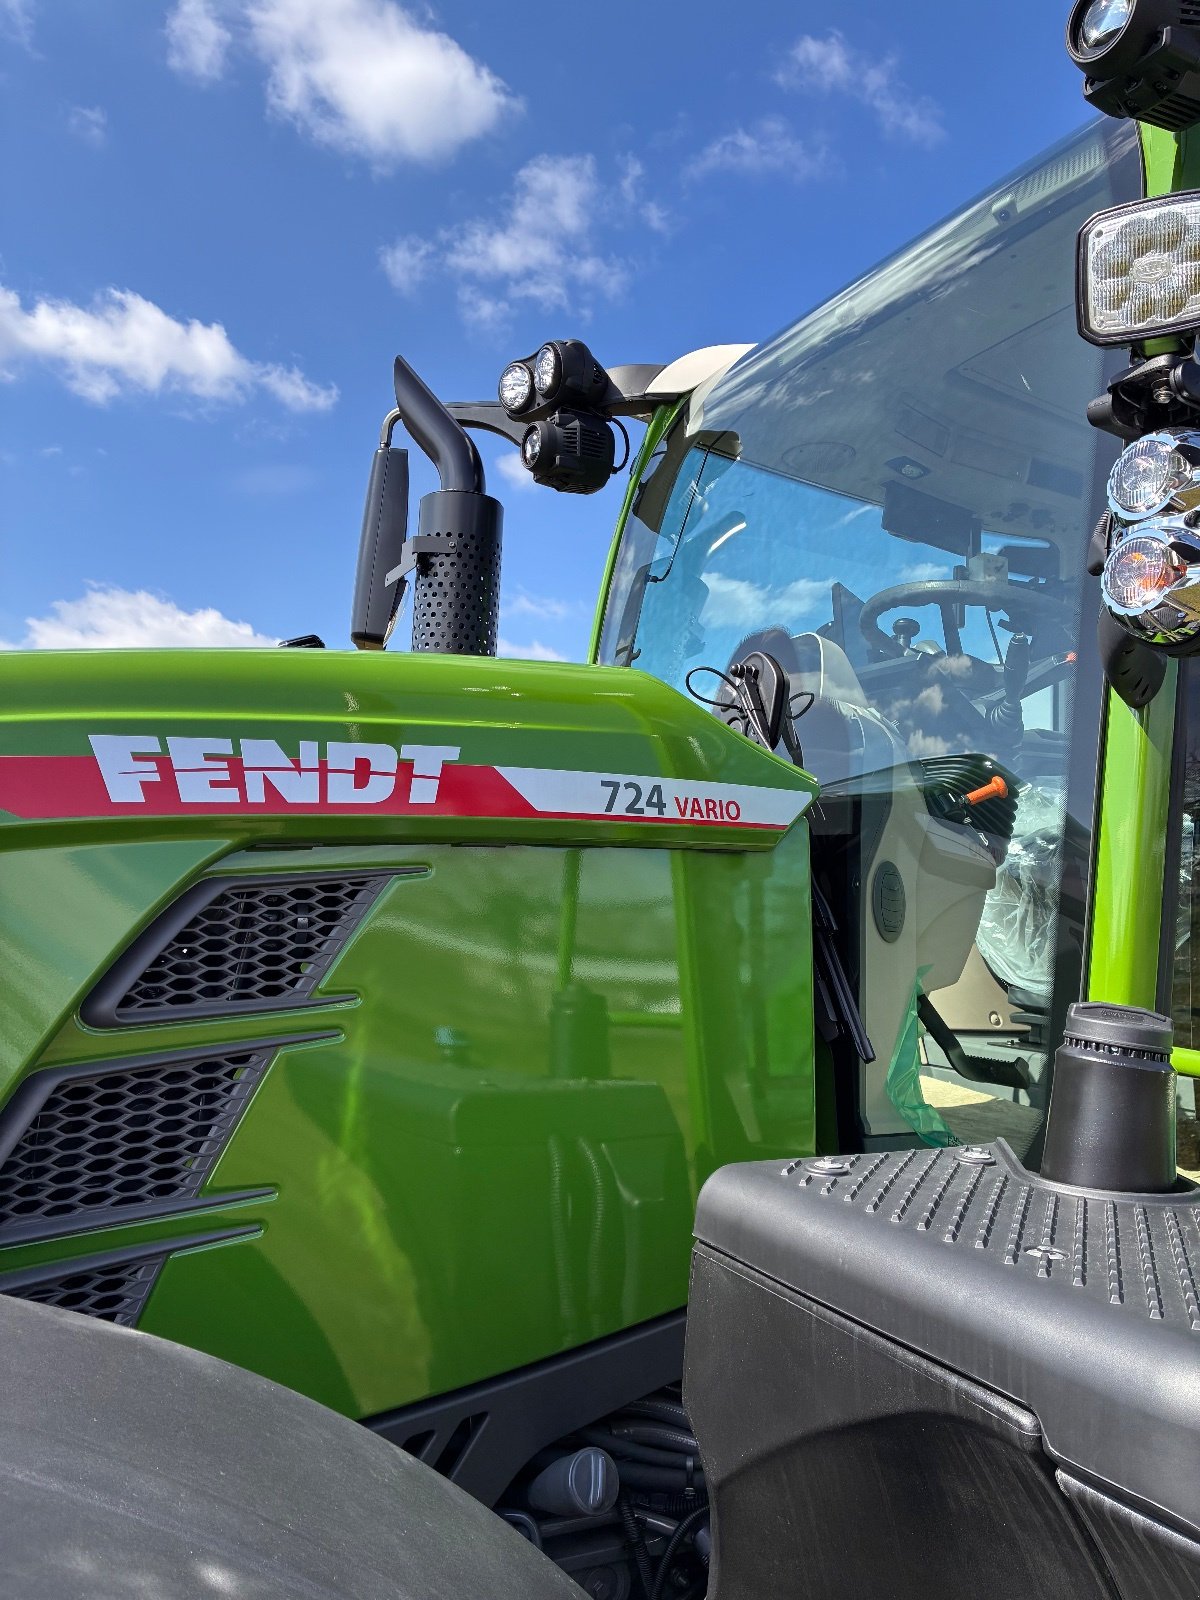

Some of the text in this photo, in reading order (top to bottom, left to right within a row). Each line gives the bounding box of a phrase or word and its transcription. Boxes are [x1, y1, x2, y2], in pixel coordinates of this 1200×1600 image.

[88, 735, 461, 803] FENDT
[600, 780, 741, 821] 724 VARIO
